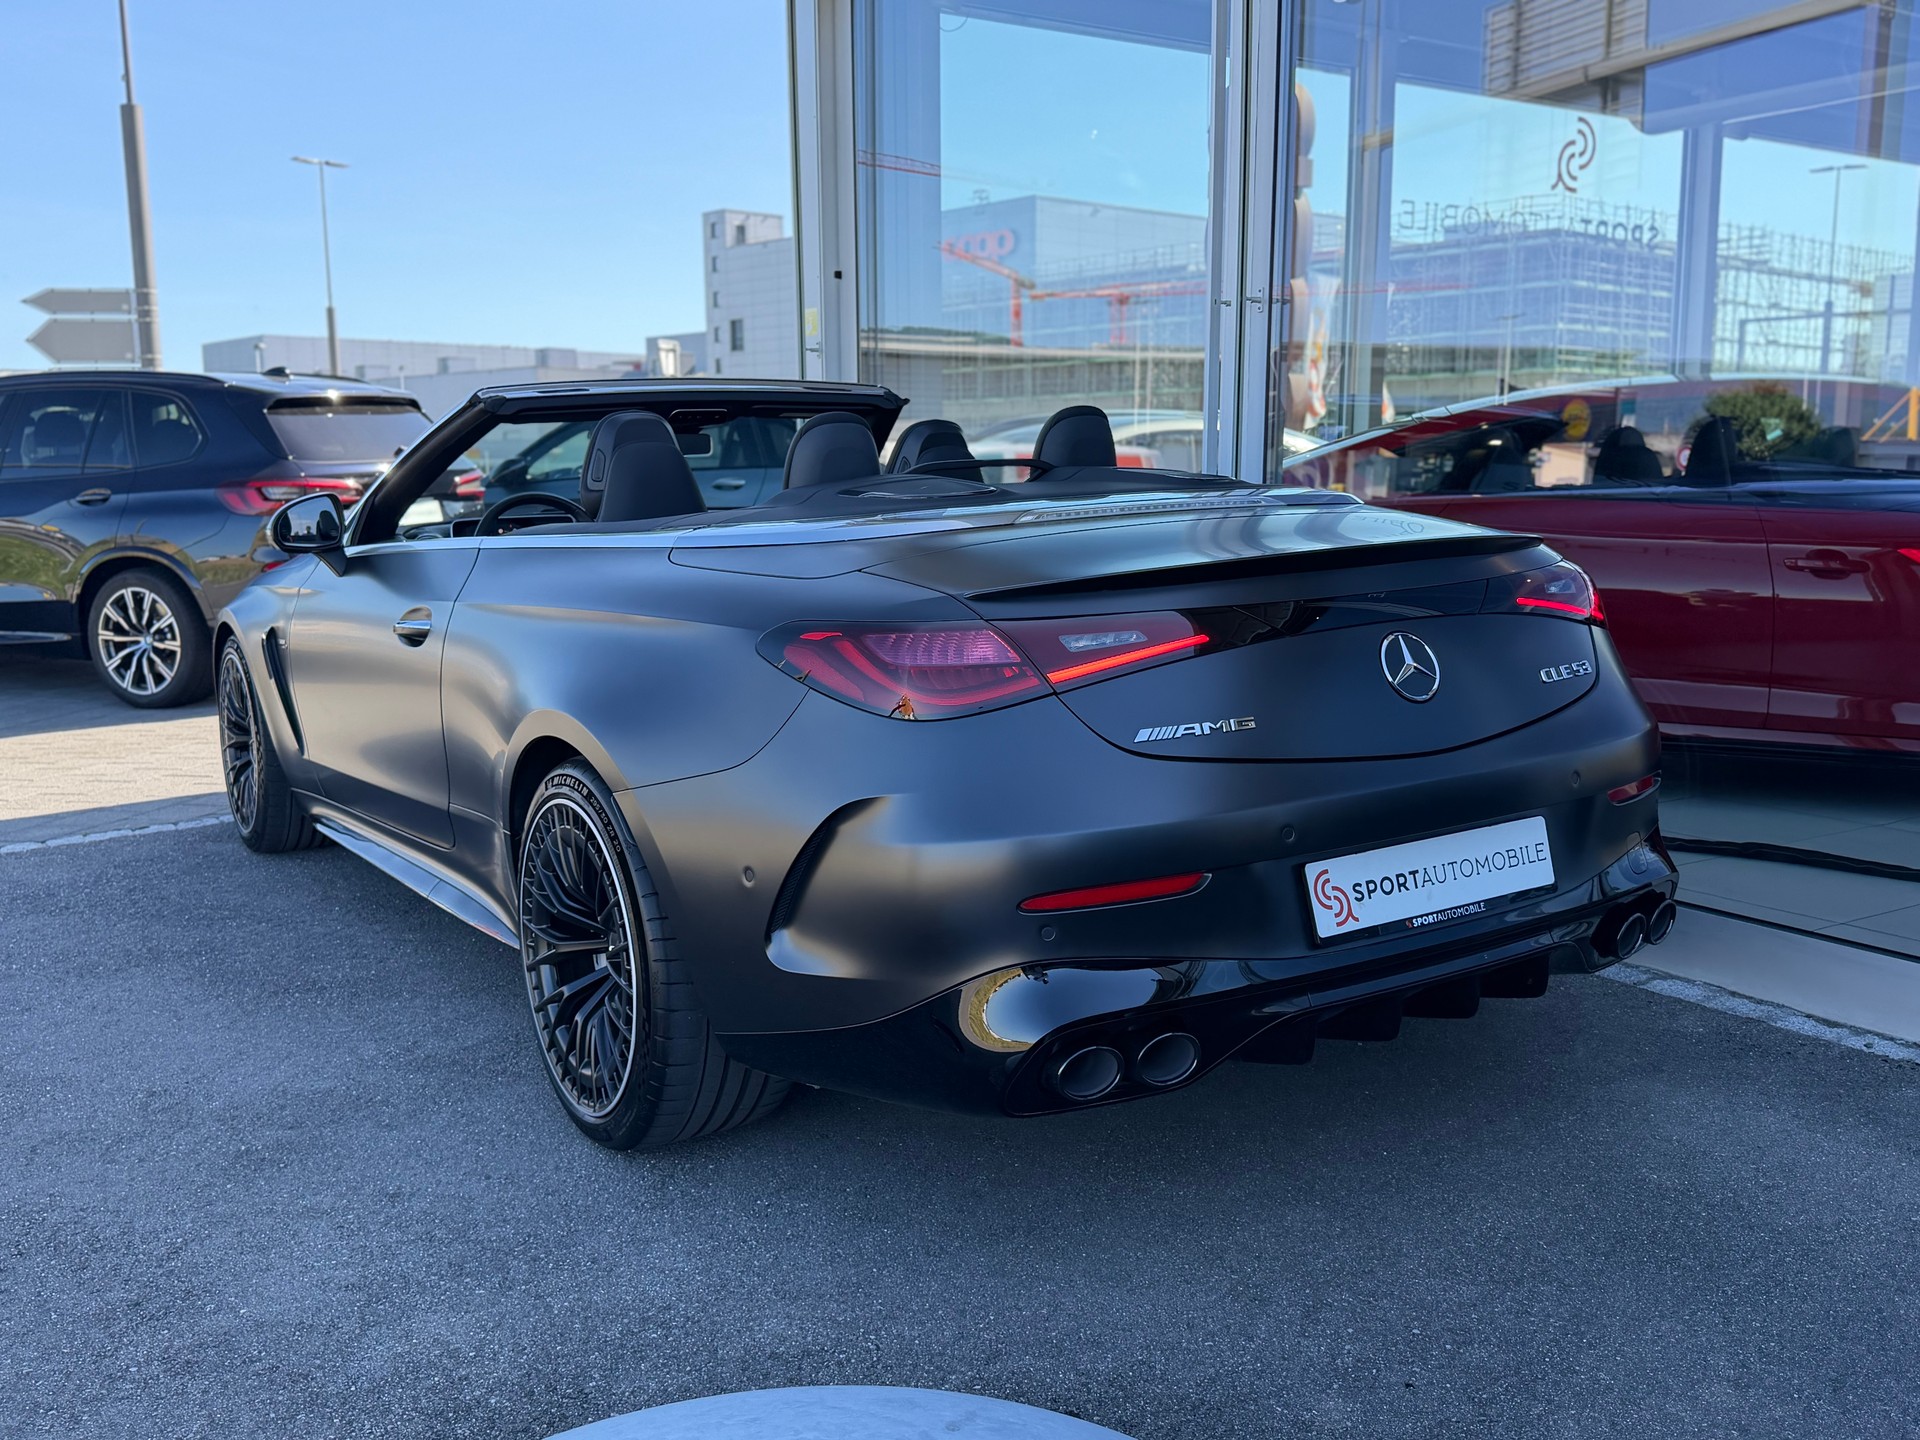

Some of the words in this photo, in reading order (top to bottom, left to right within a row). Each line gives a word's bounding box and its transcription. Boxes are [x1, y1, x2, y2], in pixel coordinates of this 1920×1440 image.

[553, 775, 589, 797] MICHELIN
[1352, 842, 1547, 903] SPORTAUTOMOBILE
[1412, 902, 1487, 928] SPORTAUTOMOBILE
